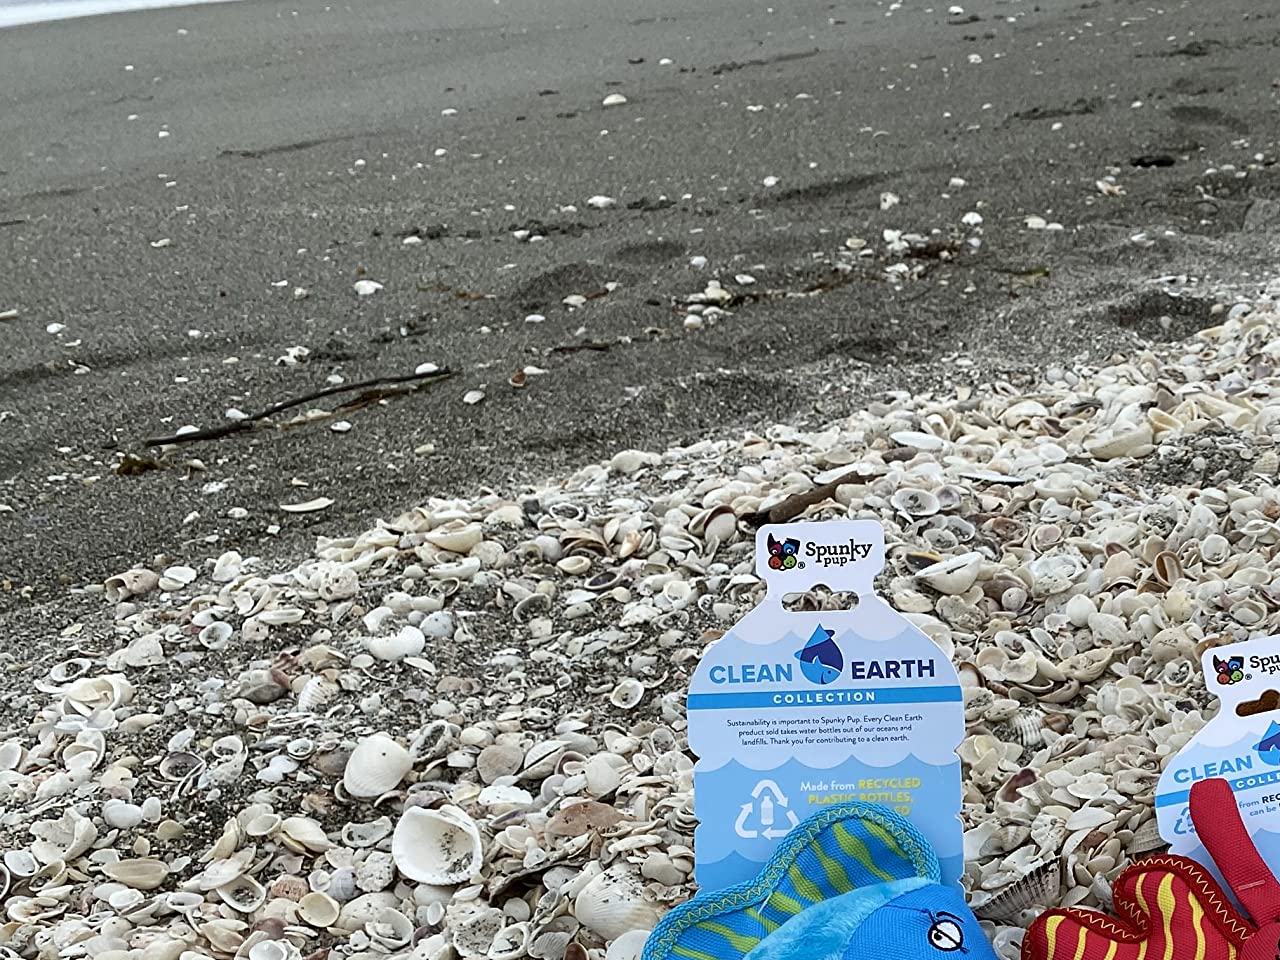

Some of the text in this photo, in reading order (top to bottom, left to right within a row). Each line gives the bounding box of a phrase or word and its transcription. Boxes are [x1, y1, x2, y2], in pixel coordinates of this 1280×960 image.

[805, 539, 872, 563] Spunky
[824, 556, 847, 567] pup
[709, 659, 935, 684] CLEAN EARTH
[773, 692, 875, 704] COLLECTION
[727, 719, 770, 728] Sustainability
[778, 718, 811, 727] important
[820, 716, 845, 726] Spunky
[863, 715, 882, 724] Every
[883, 714, 903, 722] Clean
[904, 713, 923, 722] Earth
[738, 729, 765, 738] product
[766, 728, 779, 736] sold
[818, 726, 841, 734] bottles
[855, 725, 863, 733] of
[770, 737, 790, 745] Thank
[792, 739, 804, 747] you
[816, 736, 857, 746] contributing
[890, 734, 909, 742] earth.
[1174, 755, 1253, 784] CLEAN
[800, 777, 921, 791] Made from RECYCLED
[807, 793, 856, 804] PLASTIC
[1239, 800, 1260, 809] from
[1249, 808, 1265, 816] can
[1266, 805, 1277, 813] be
